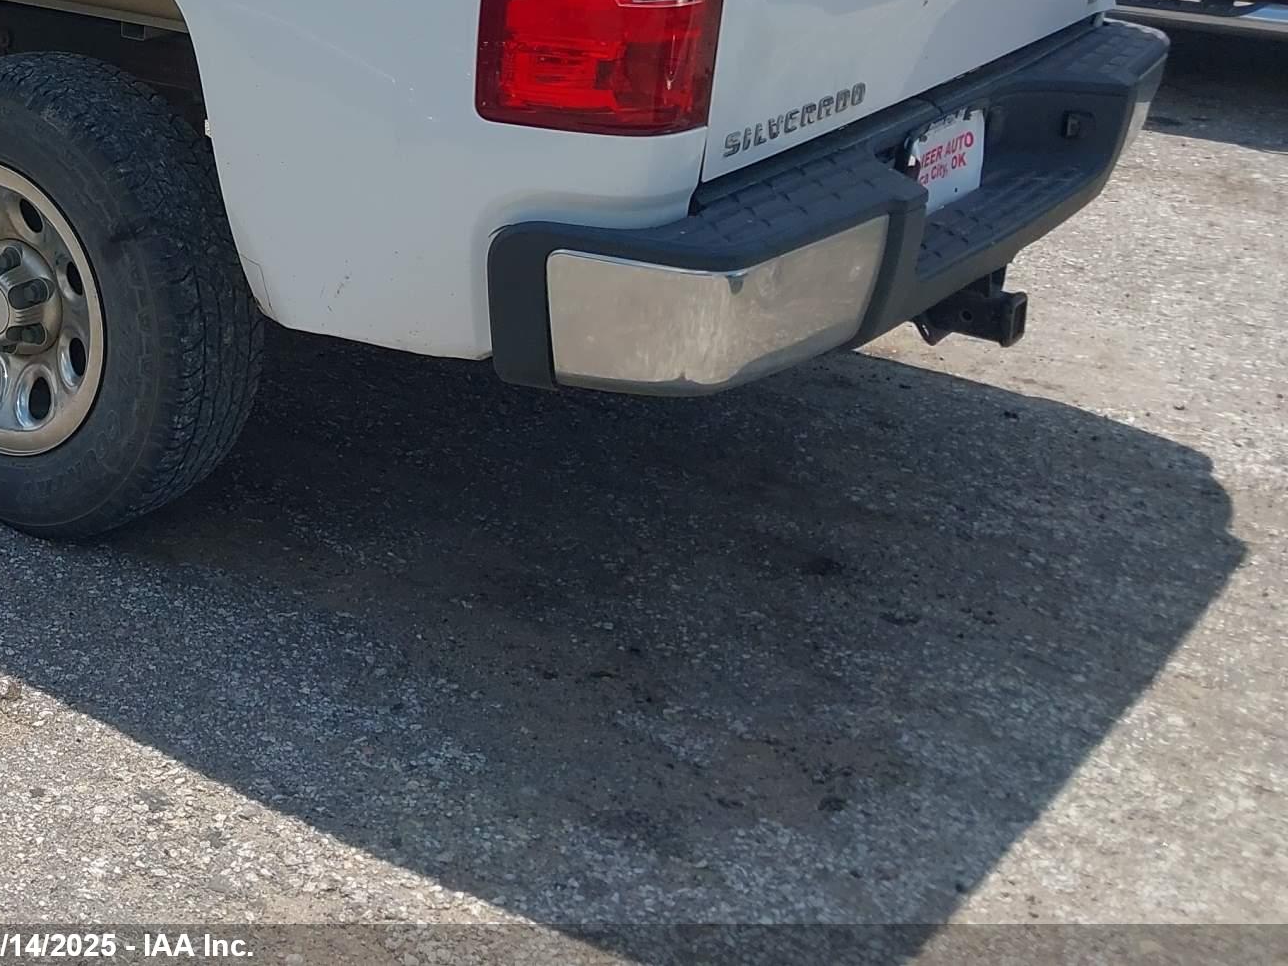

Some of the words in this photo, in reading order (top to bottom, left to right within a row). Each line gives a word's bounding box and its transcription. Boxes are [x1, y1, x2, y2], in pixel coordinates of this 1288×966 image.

[723, 82, 866, 157] SILVERADO
[945, 131, 974, 155] AUTO
[951, 152, 967, 169] OK
